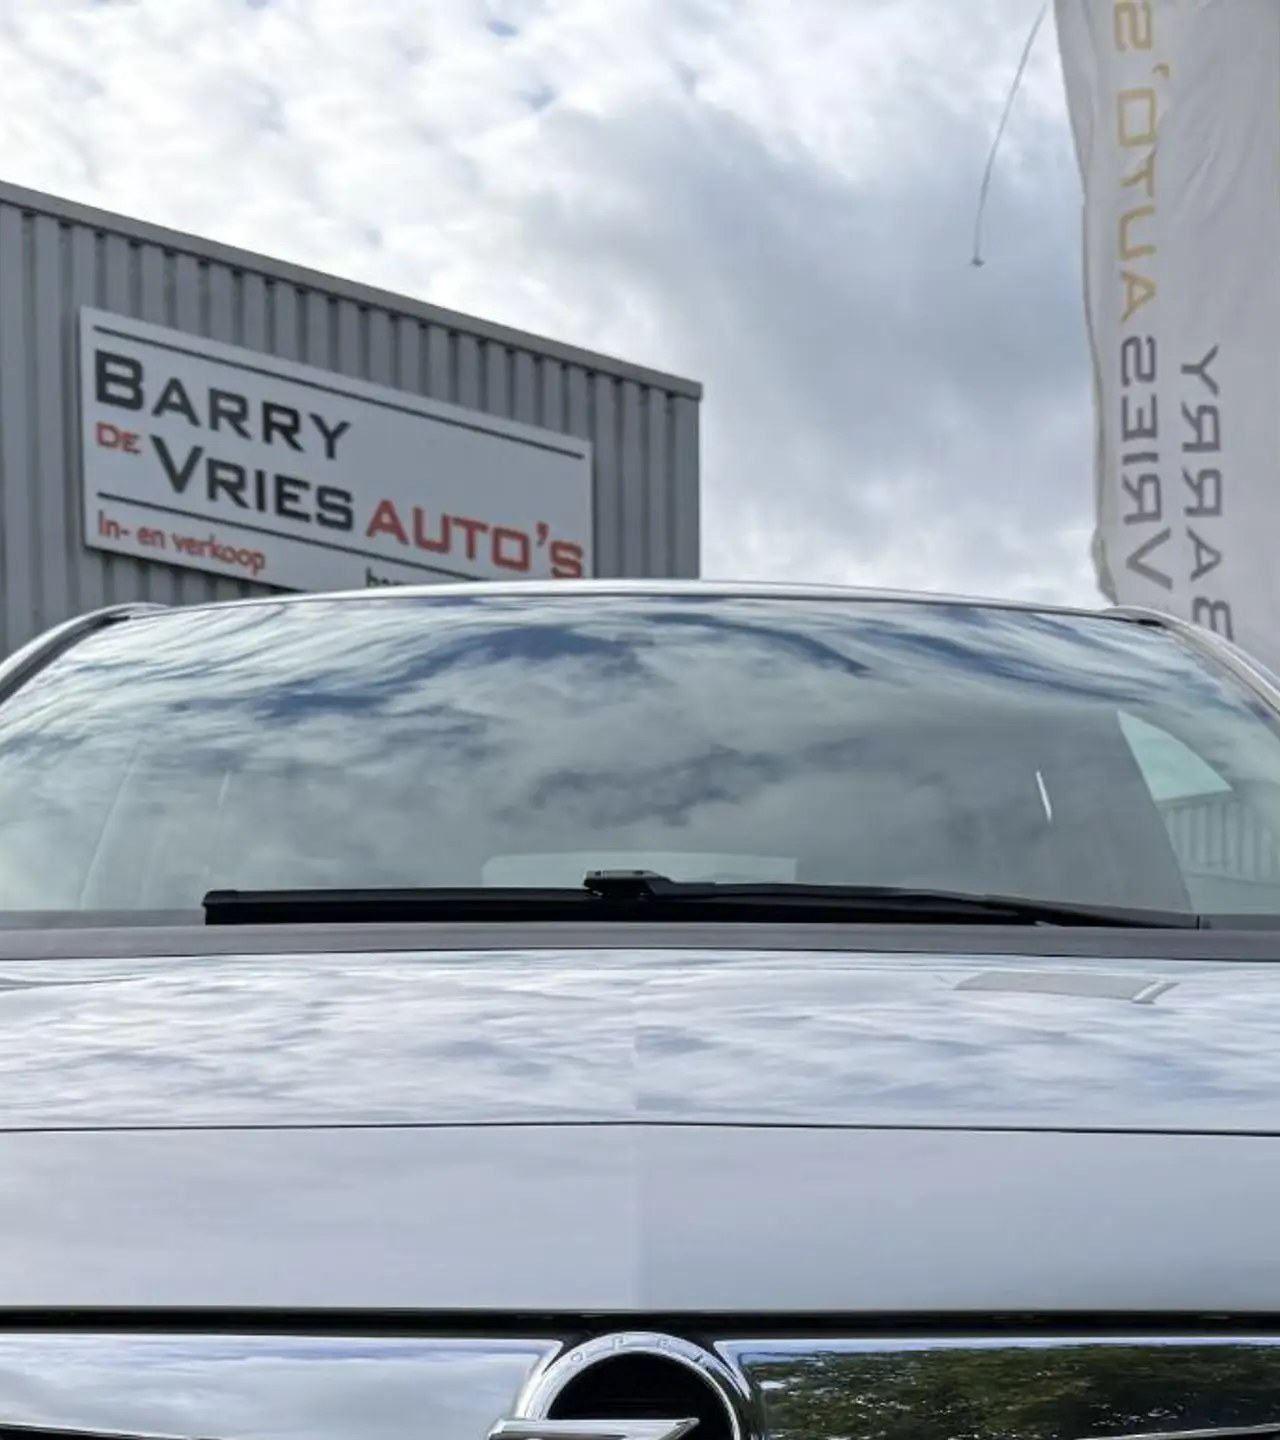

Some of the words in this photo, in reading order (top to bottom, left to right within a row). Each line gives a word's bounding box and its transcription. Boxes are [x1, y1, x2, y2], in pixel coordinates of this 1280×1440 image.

[94, 349, 352, 460] BARRY
[97, 509, 131, 541] In-
[136, 525, 167, 549] en
[171, 532, 267, 577] verkoop
[150, 433, 355, 532] VRIES
[365, 499, 585, 580] AUTO'S
